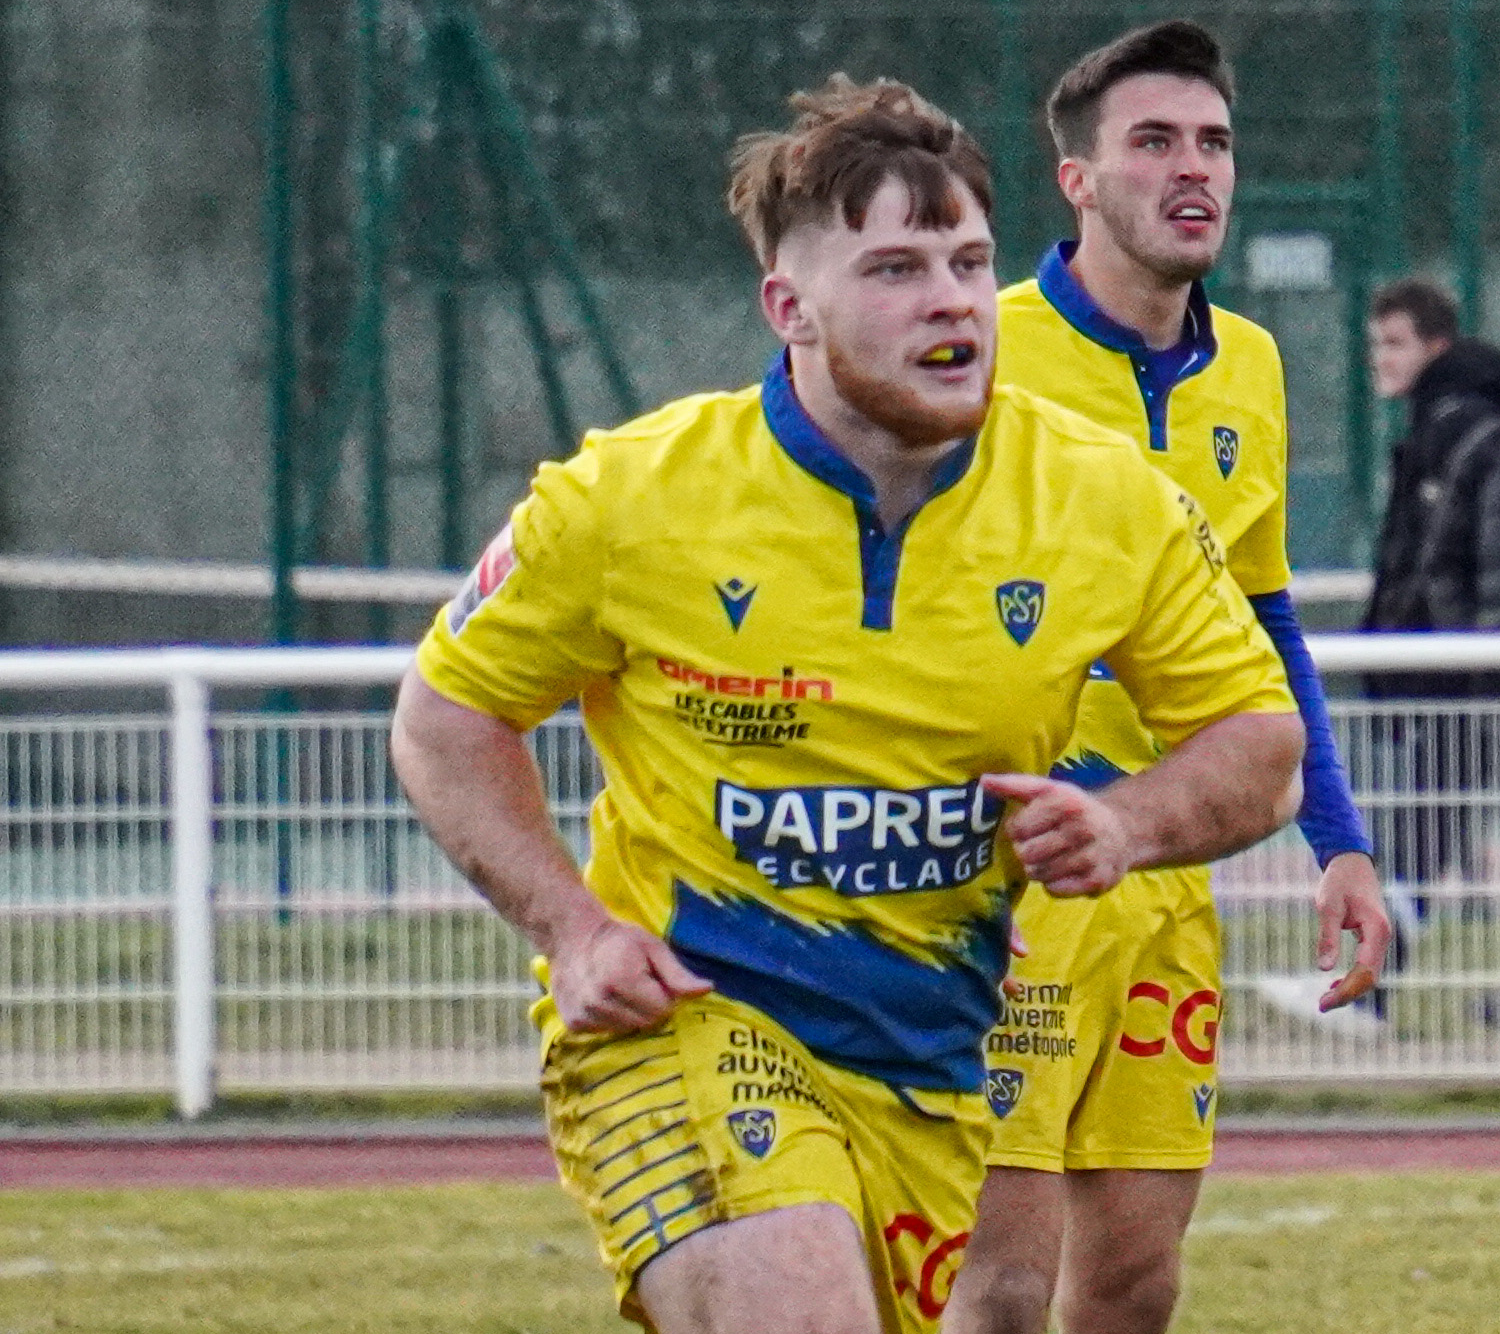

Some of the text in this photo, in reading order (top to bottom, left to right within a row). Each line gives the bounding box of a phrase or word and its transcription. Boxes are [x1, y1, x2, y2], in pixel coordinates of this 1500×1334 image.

[709, 701, 799, 721] CABLES
[756, 839, 991, 892] ECYCLAGE
[1119, 981, 1220, 1066] CG
